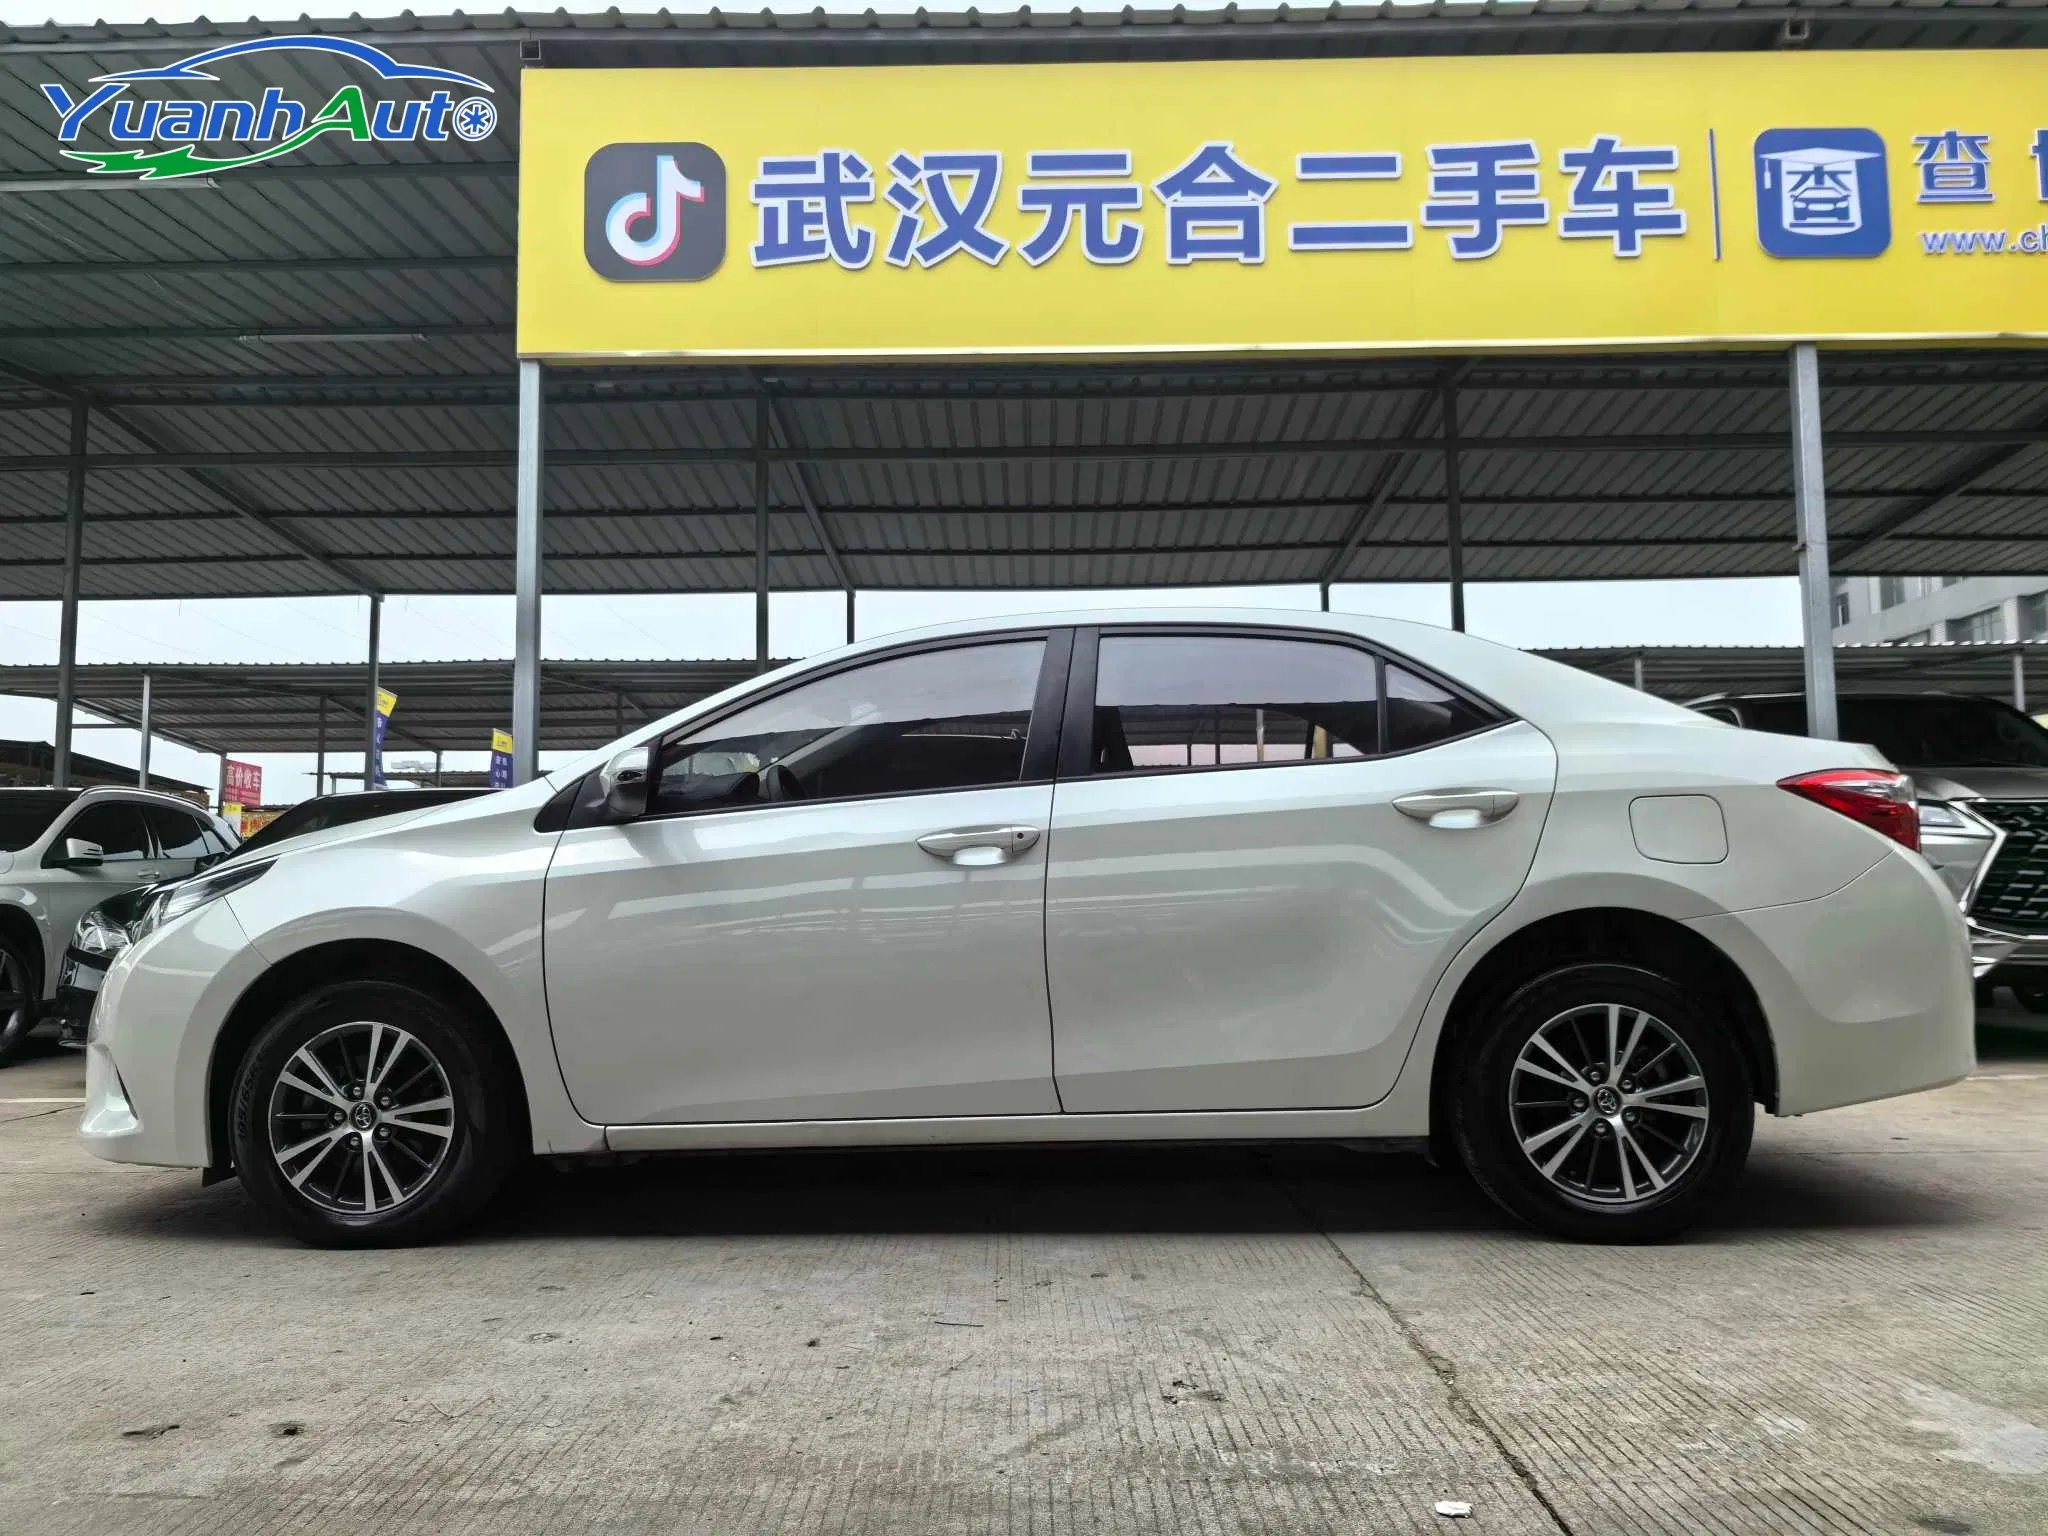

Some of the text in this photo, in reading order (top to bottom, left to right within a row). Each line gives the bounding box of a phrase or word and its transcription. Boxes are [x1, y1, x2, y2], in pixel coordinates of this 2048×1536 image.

[752, 133, 1687, 269] 武汉元合二手车
